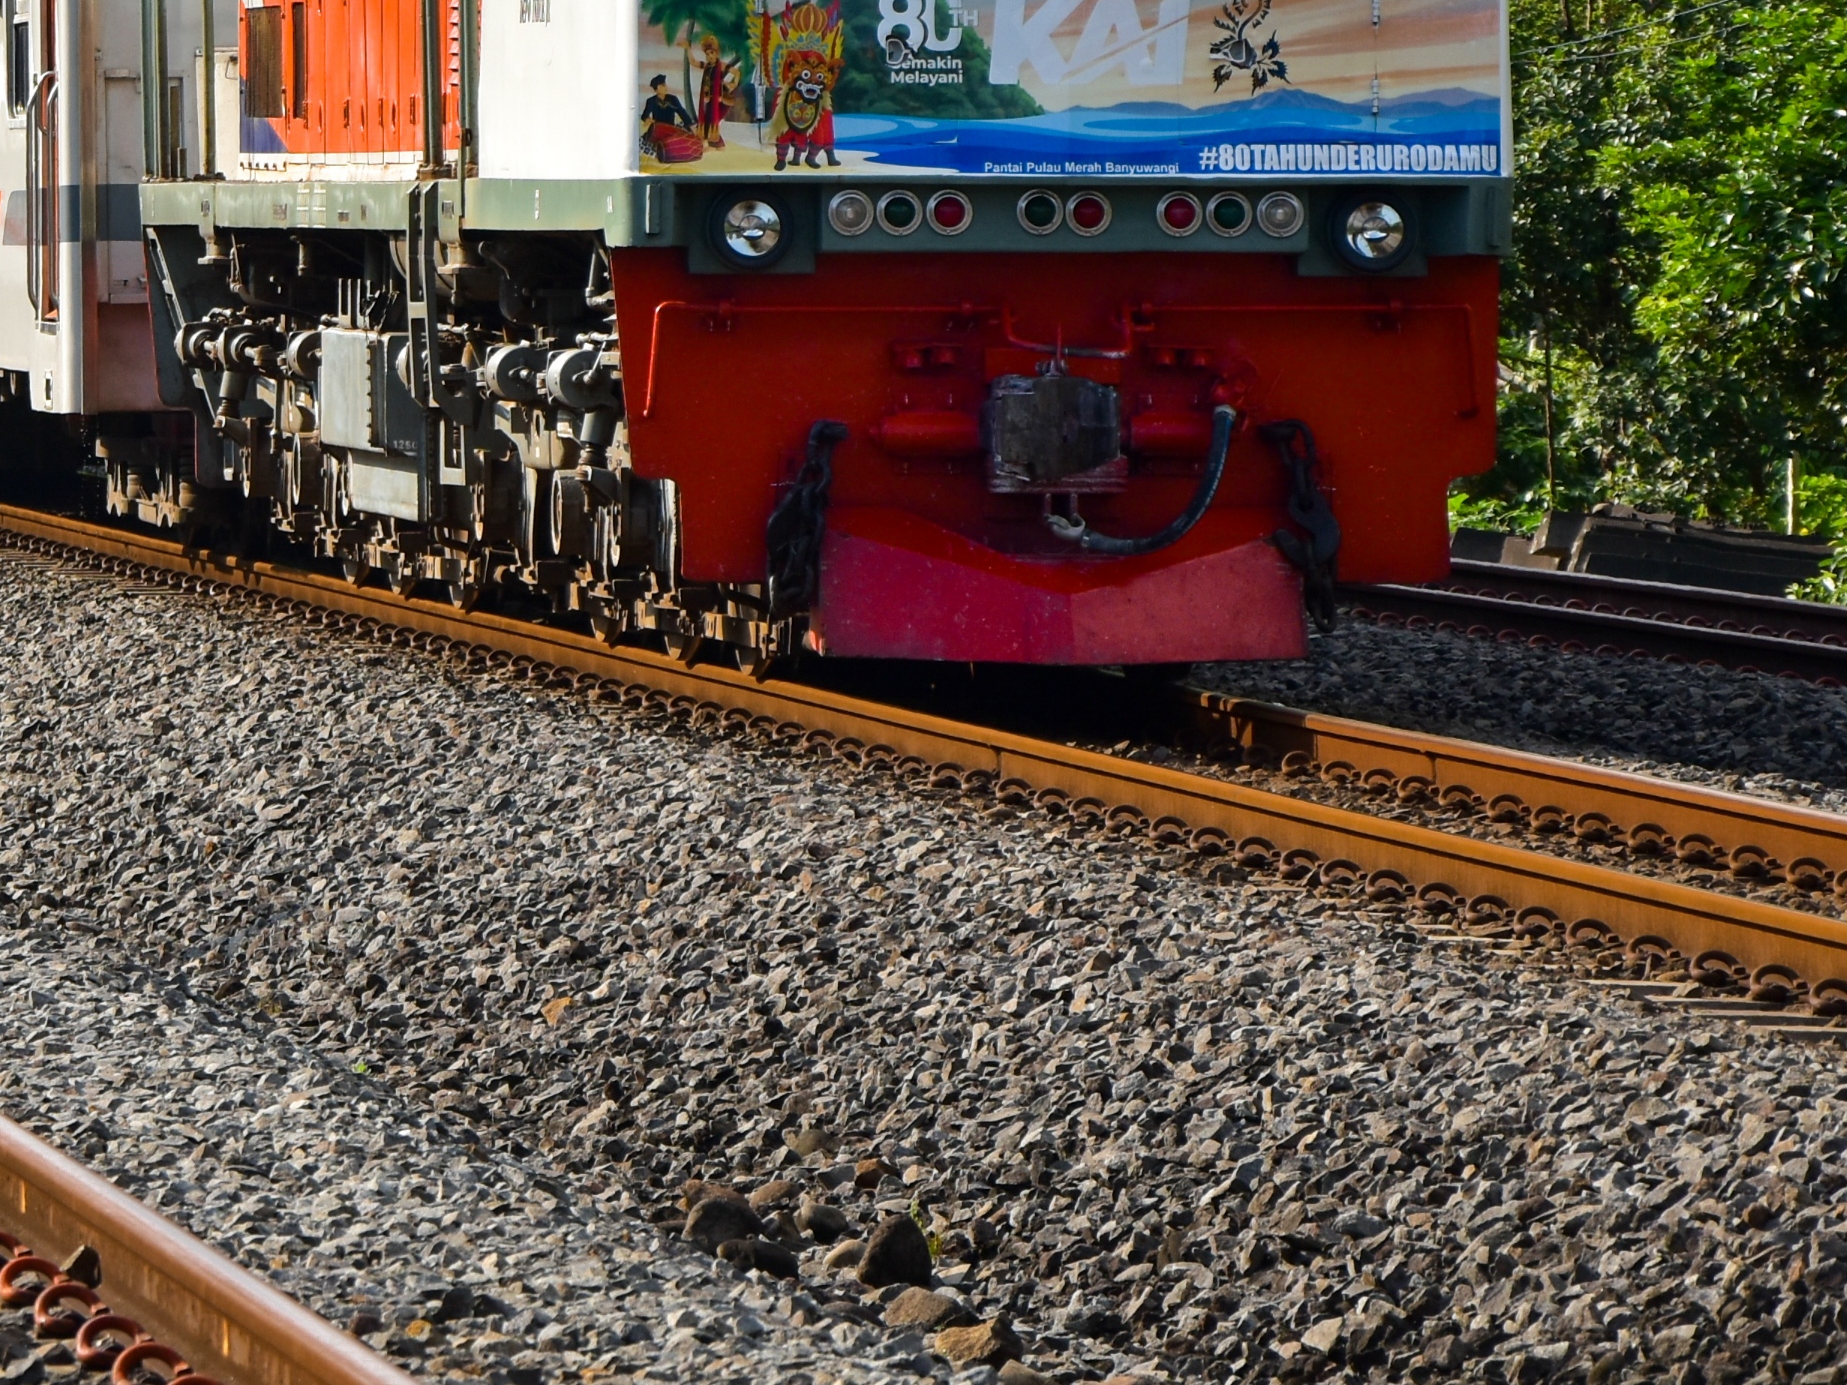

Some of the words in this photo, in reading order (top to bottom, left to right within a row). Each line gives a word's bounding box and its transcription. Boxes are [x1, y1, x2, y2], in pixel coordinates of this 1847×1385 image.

[890, 70, 963, 86] Melayani
[1199, 144, 1497, 171] #80TAHUNDERURODAMU
[984, 162, 1022, 173] Pantai
[1026, 162, 1061, 173] Pulau
[1065, 162, 1102, 173] Merah
[1105, 162, 1179, 174] Banyuwangi
